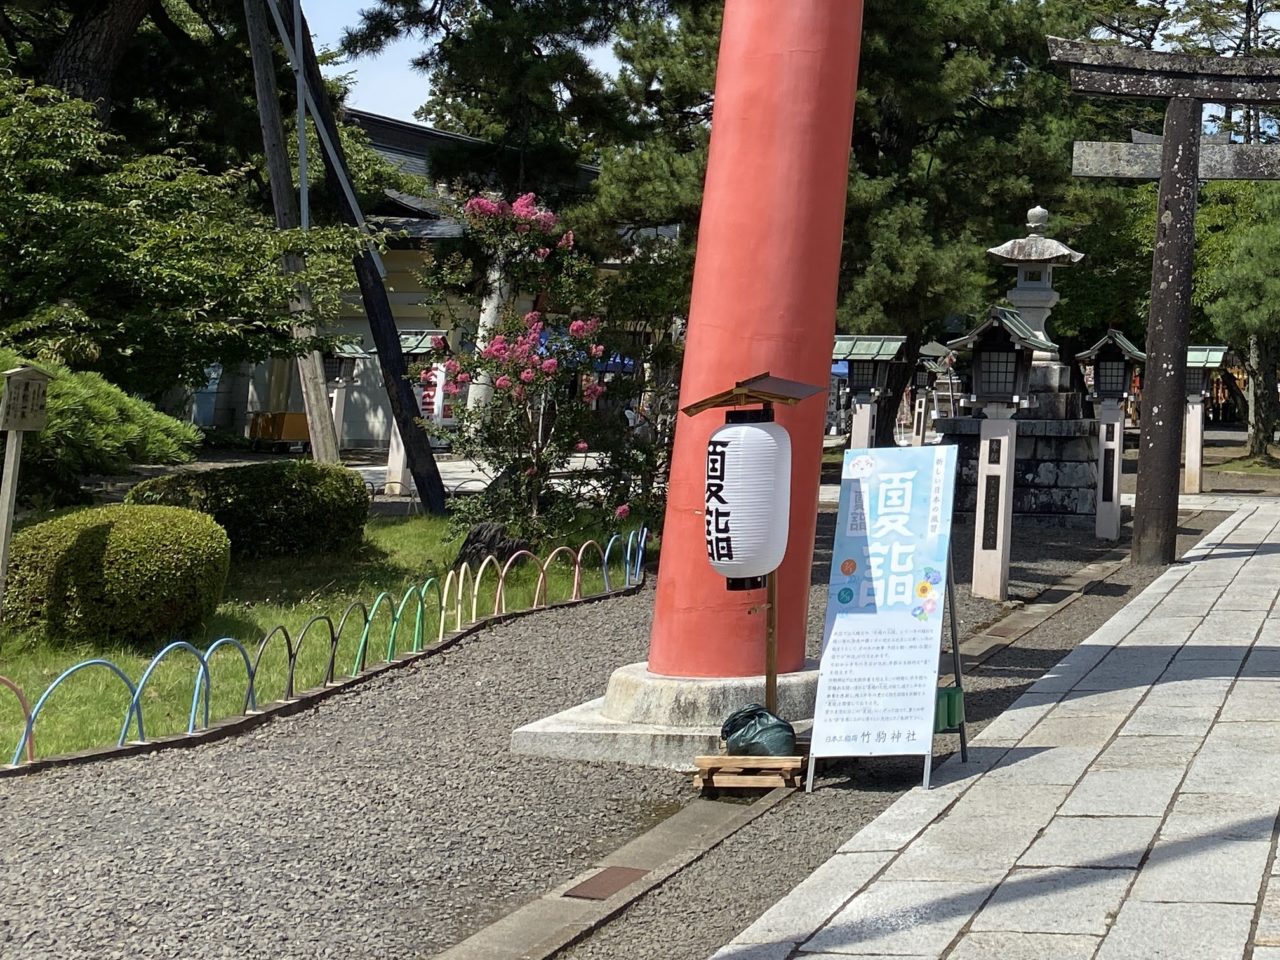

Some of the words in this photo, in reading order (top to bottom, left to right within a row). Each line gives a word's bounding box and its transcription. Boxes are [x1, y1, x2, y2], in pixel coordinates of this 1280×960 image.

[859, 470, 918, 608] 夏詣
[860, 729, 917, 744] 竹駒神社
